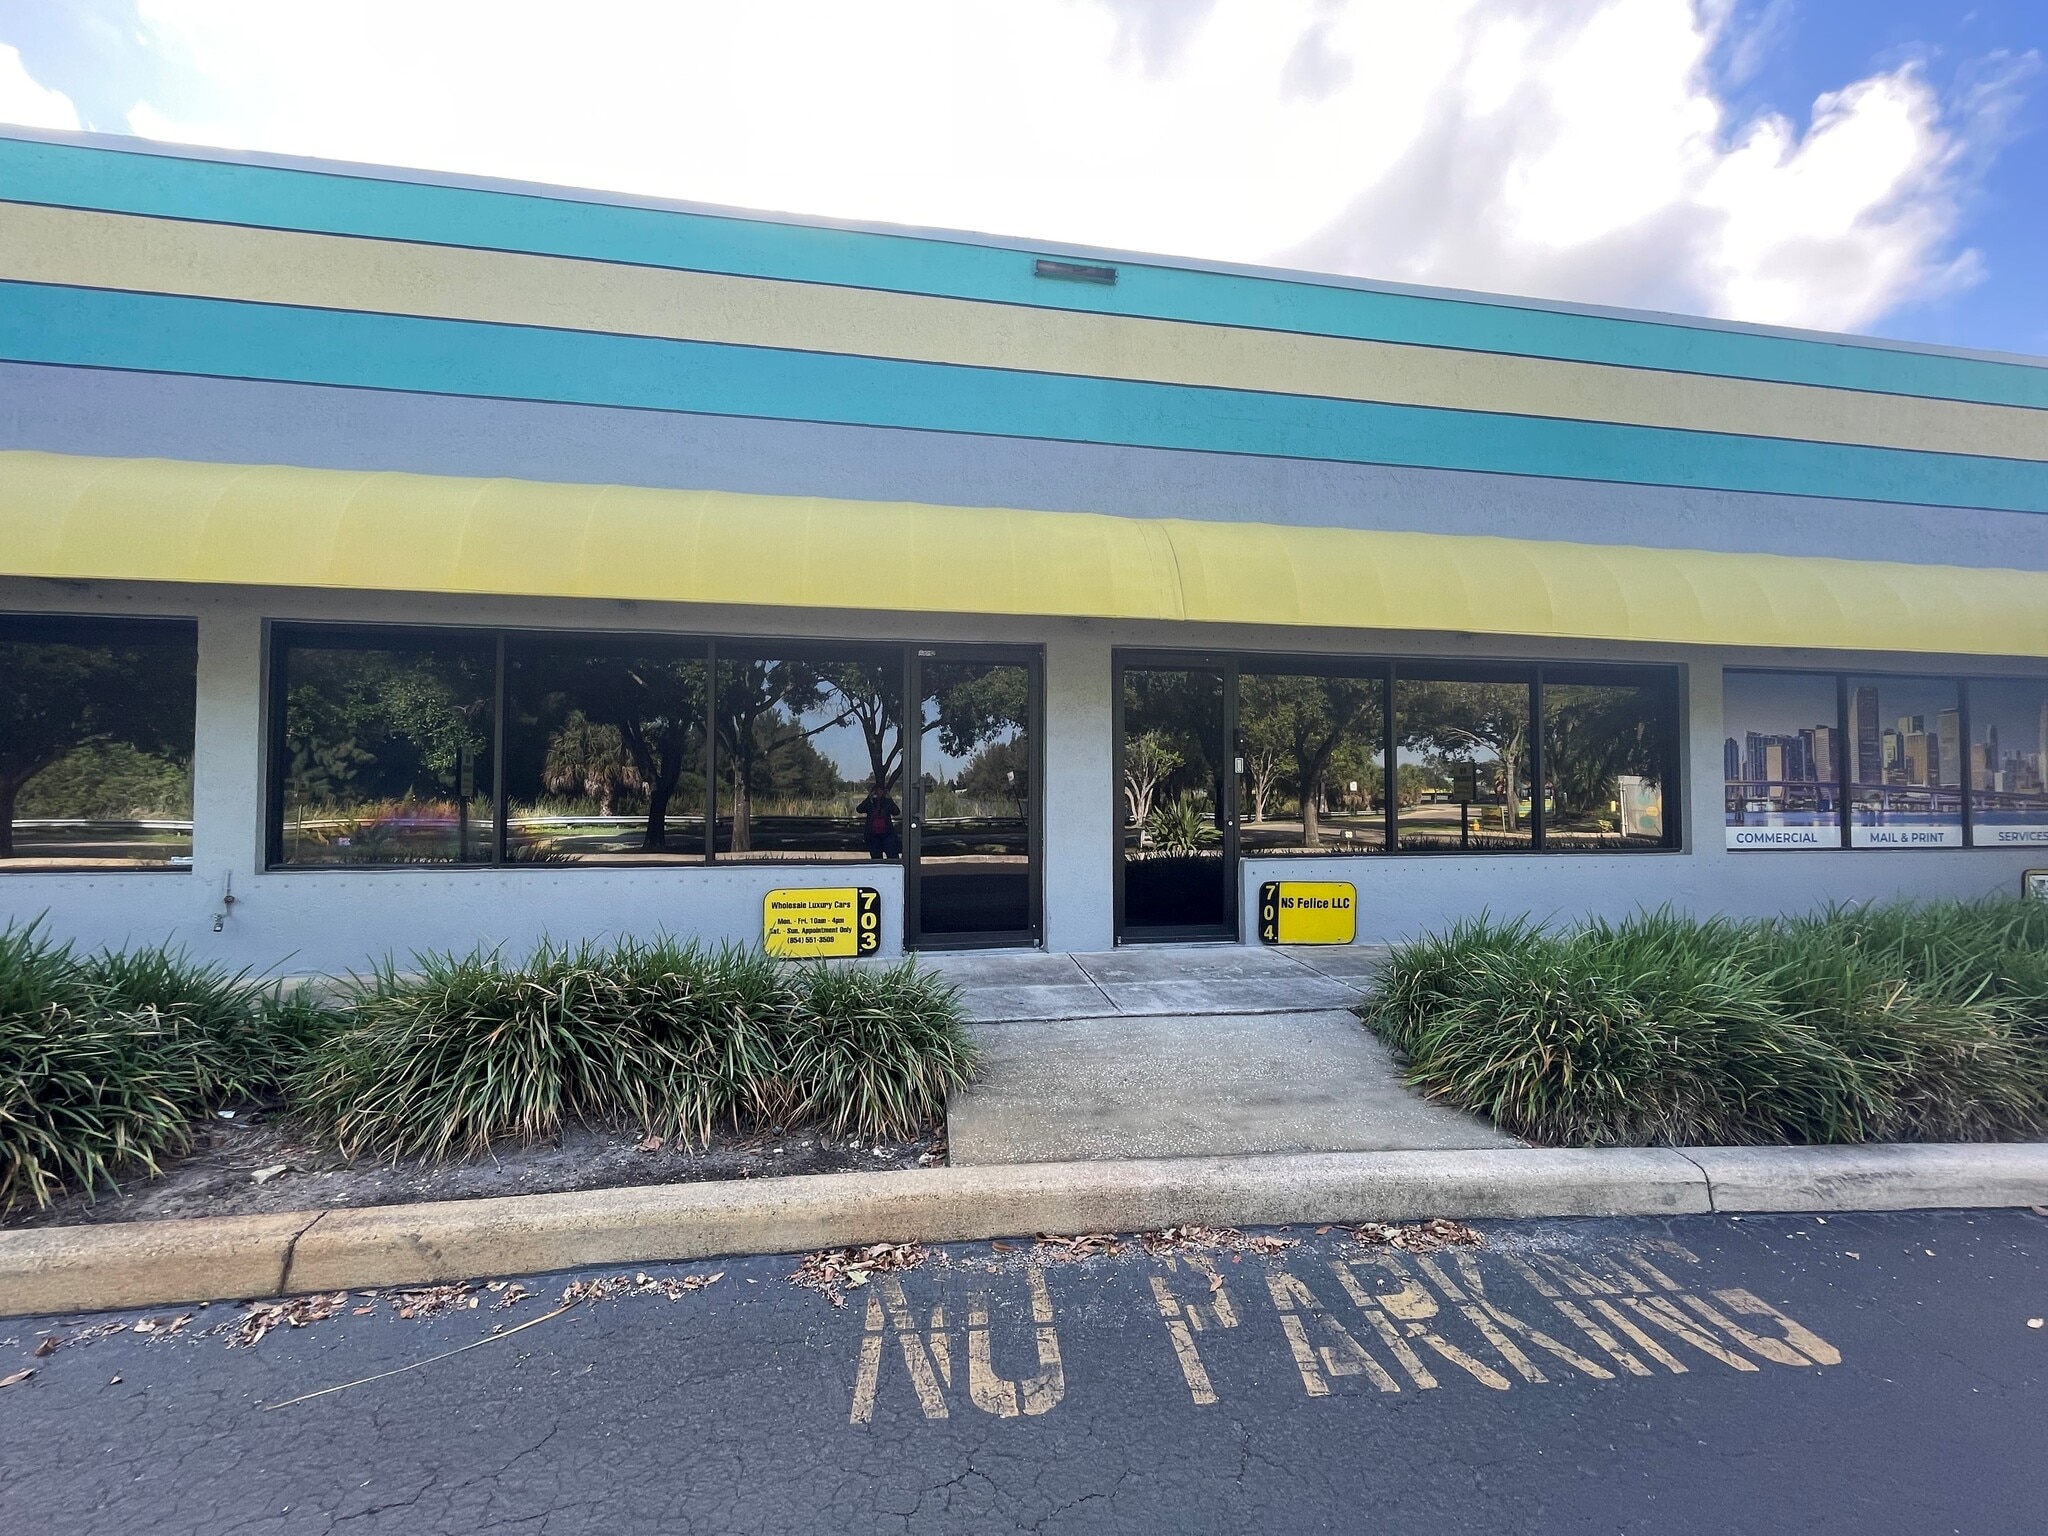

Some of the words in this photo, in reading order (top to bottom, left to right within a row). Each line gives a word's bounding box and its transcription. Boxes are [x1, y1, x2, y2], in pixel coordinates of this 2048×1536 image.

[1735, 832, 1818, 844] COMMERCIAL
[1869, 832, 1898, 843] MAIL
[1900, 832, 1909, 843] &
[1911, 832, 1945, 843] PRINT
[1998, 831, 2048, 842] SERVICES
[771, 901, 807, 909] Wholesale
[808, 901, 833, 910] Luxury
[834, 900, 851, 909] Cars
[1280, 897, 1294, 909] NS
[1297, 897, 1329, 909] Felice
[1331, 897, 1350, 909] LLC
[1263, 885, 1276, 940] 704
[860, 892, 877, 950] 703
[801, 926, 838, 935] Appointment
[839, 926, 853, 934] Only
